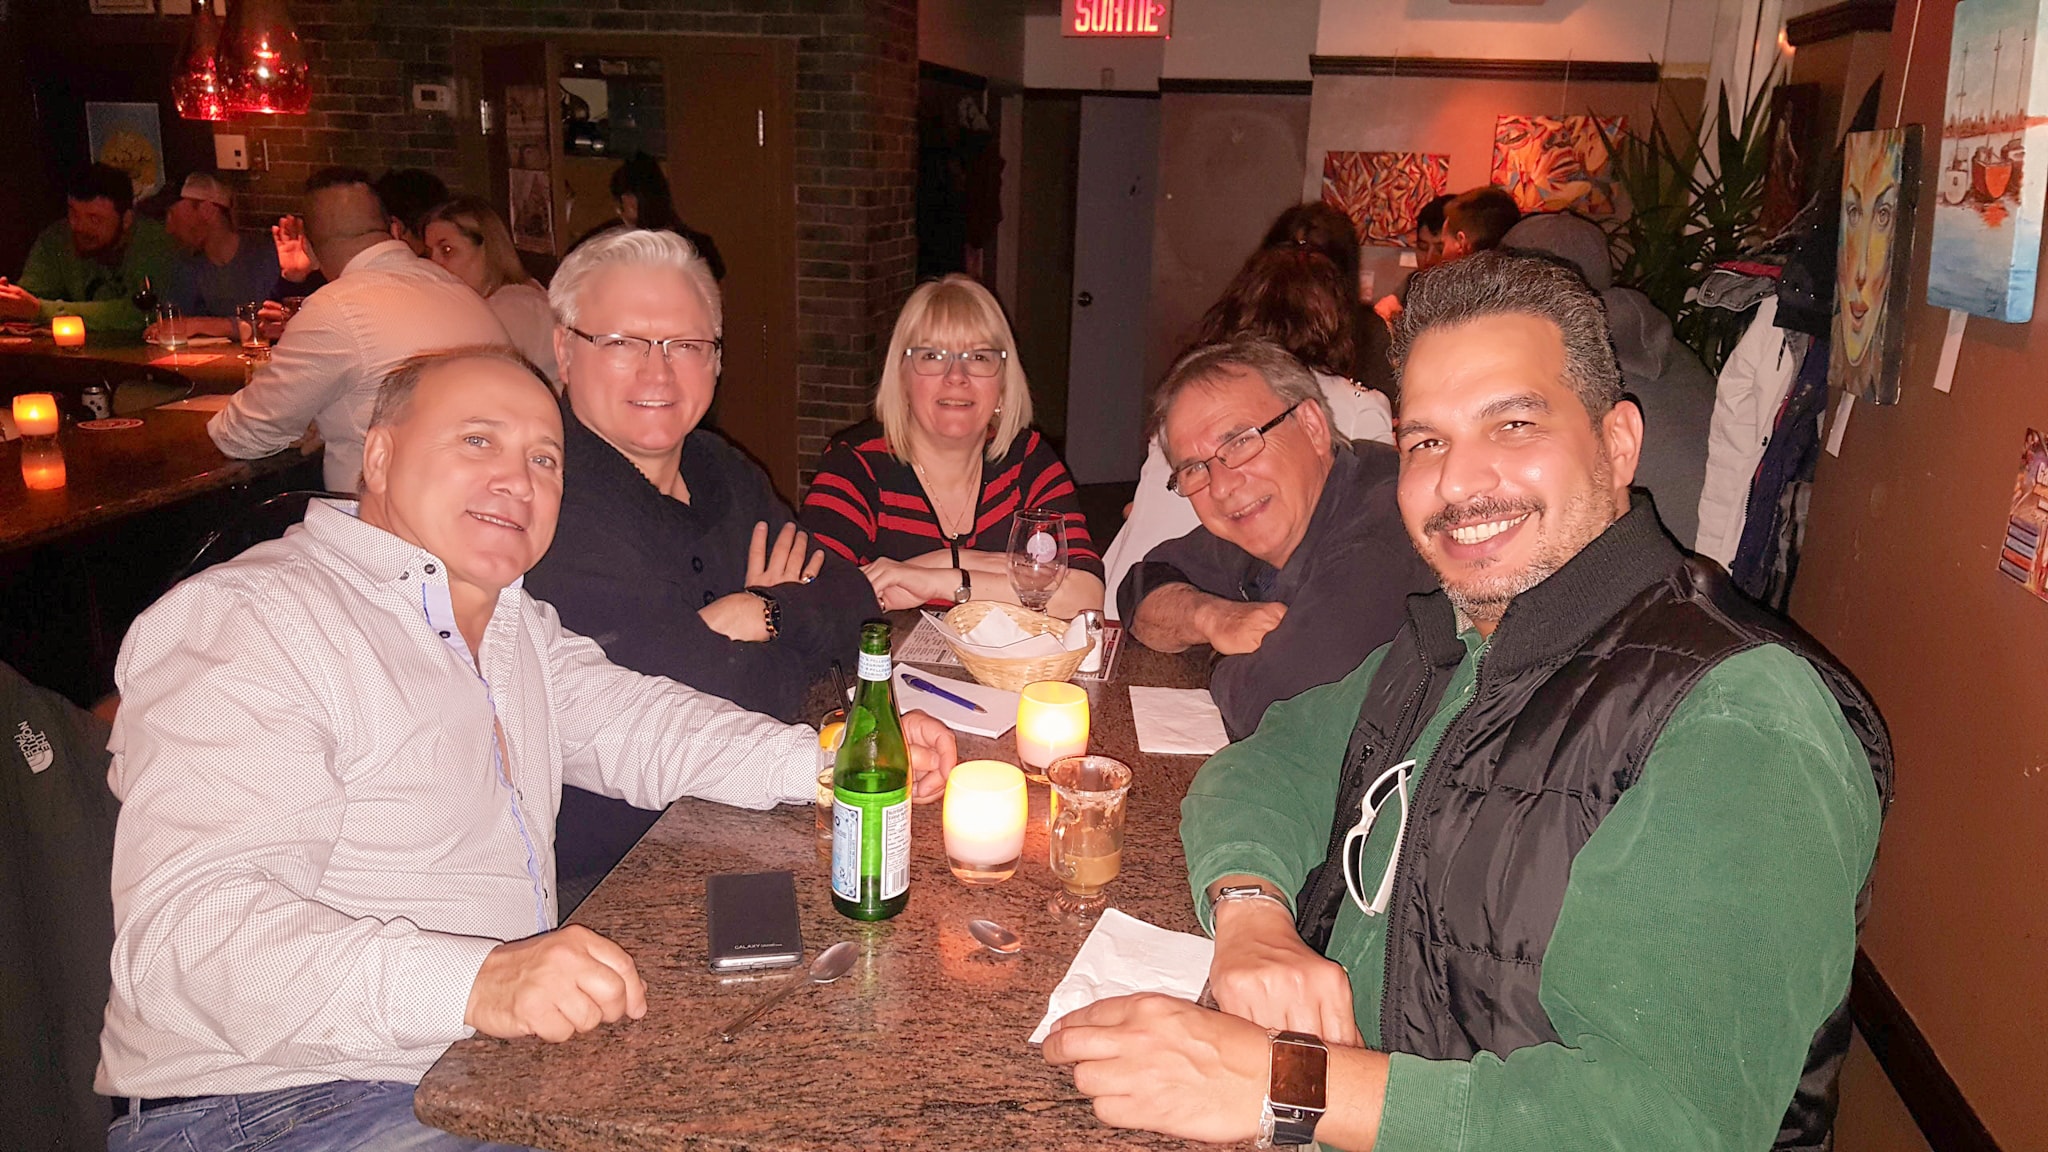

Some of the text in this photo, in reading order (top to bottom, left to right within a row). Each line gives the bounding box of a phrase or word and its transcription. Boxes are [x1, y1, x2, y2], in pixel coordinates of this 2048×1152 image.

[1075, 0, 1159, 32] SORTIE
[13, 733, 34, 759] FACE
[17, 720, 43, 755] NORTH
[35, 730, 51, 752] THE
